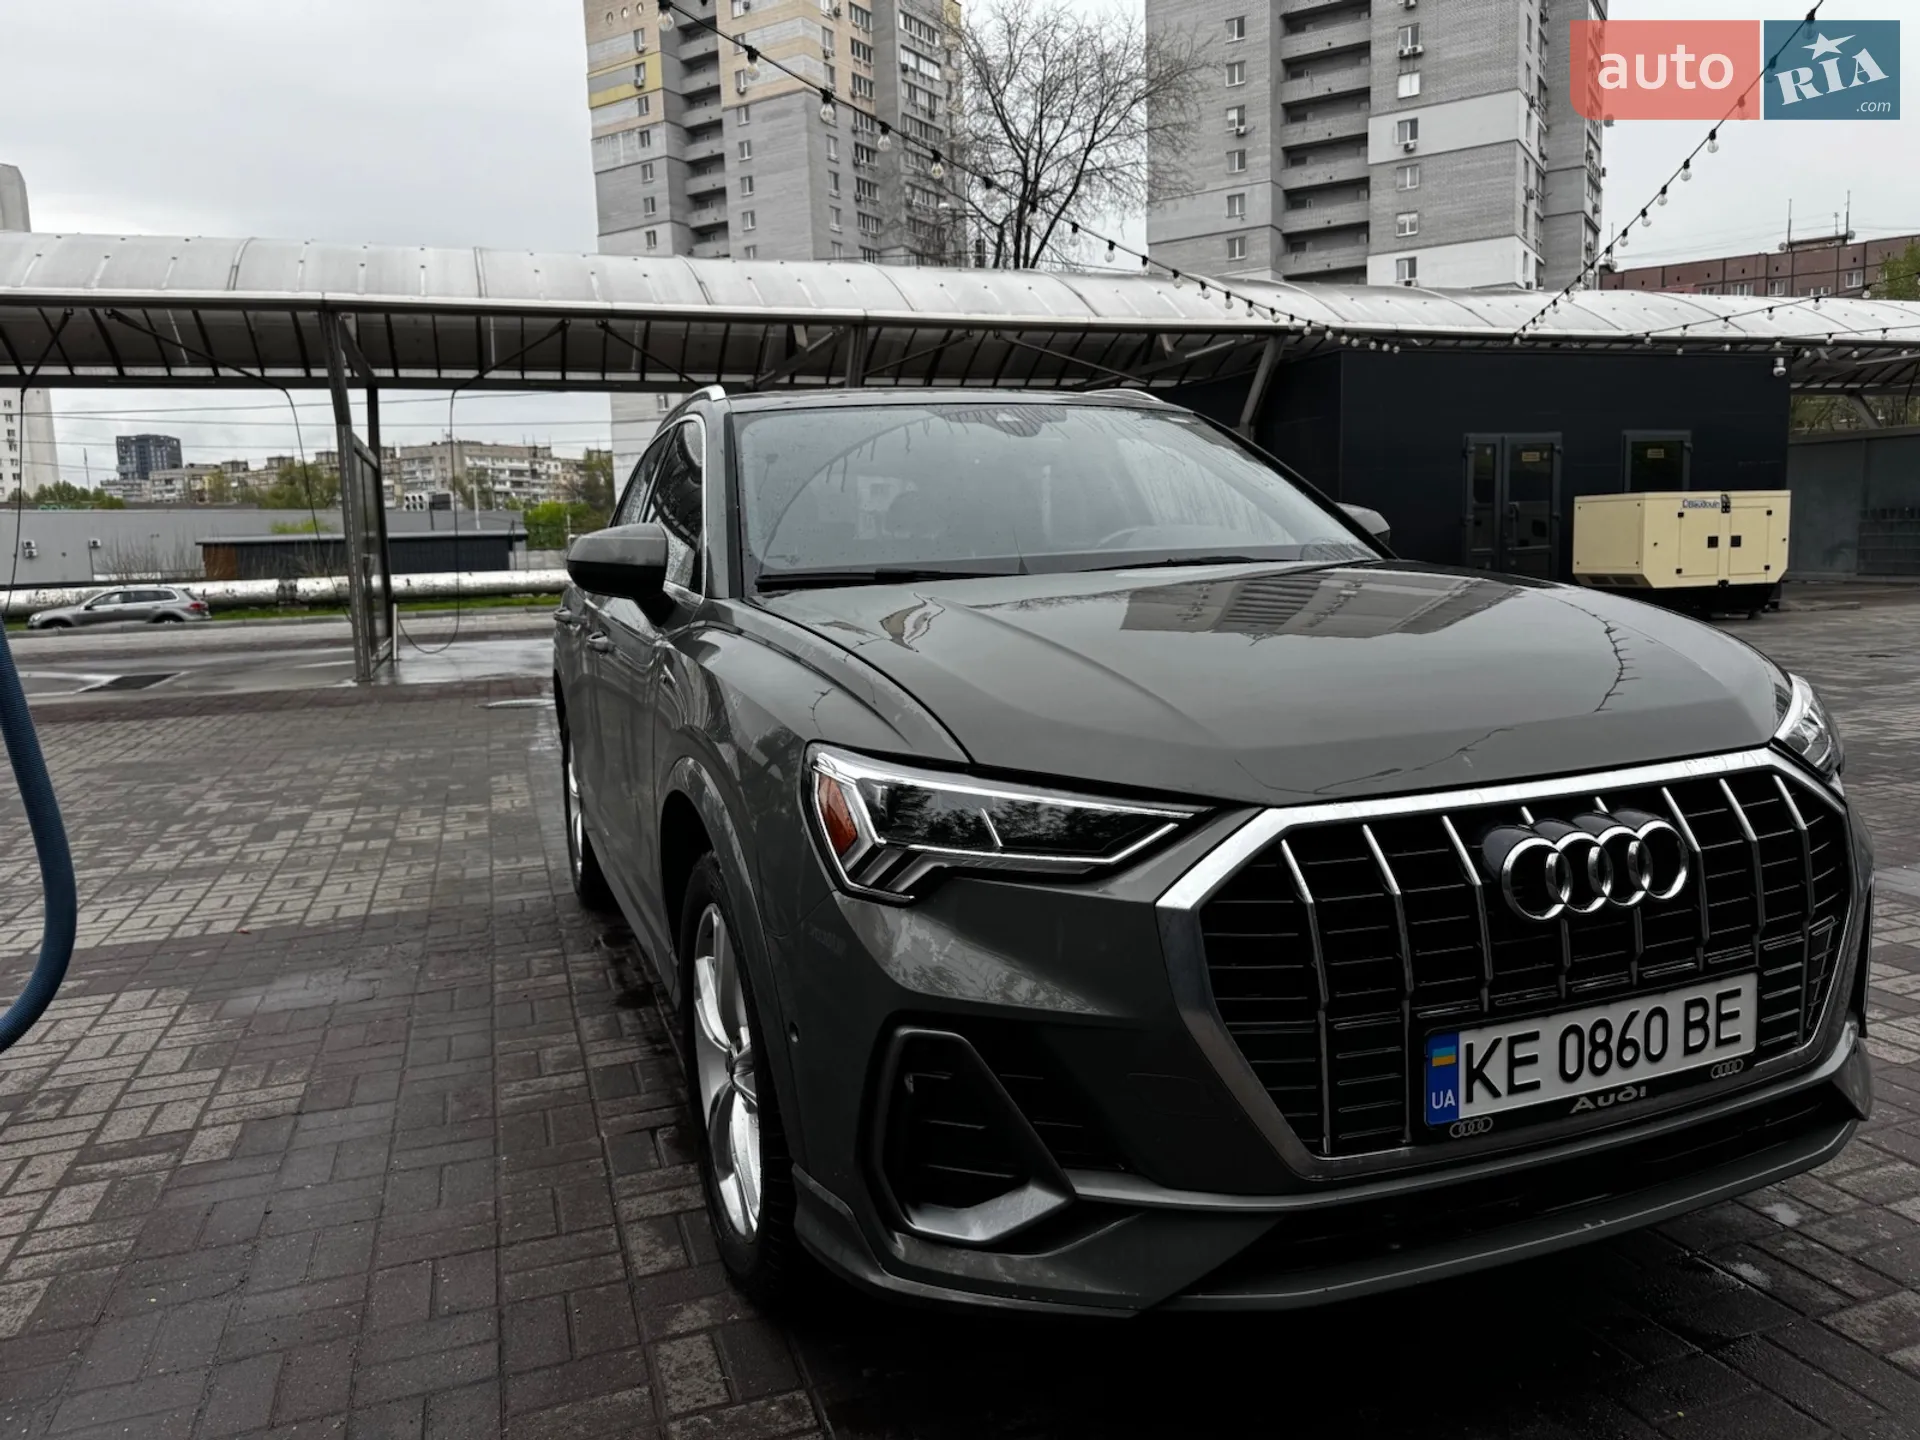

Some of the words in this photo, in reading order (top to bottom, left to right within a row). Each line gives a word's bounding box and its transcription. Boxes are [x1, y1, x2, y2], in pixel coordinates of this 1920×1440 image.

[1465, 1030, 1541, 1104] KE
[1558, 1005, 1669, 1083] 0860
[1683, 987, 1743, 1057] BE
[1431, 1088, 1456, 1110] UA
[1569, 1085, 1647, 1114] Audi
